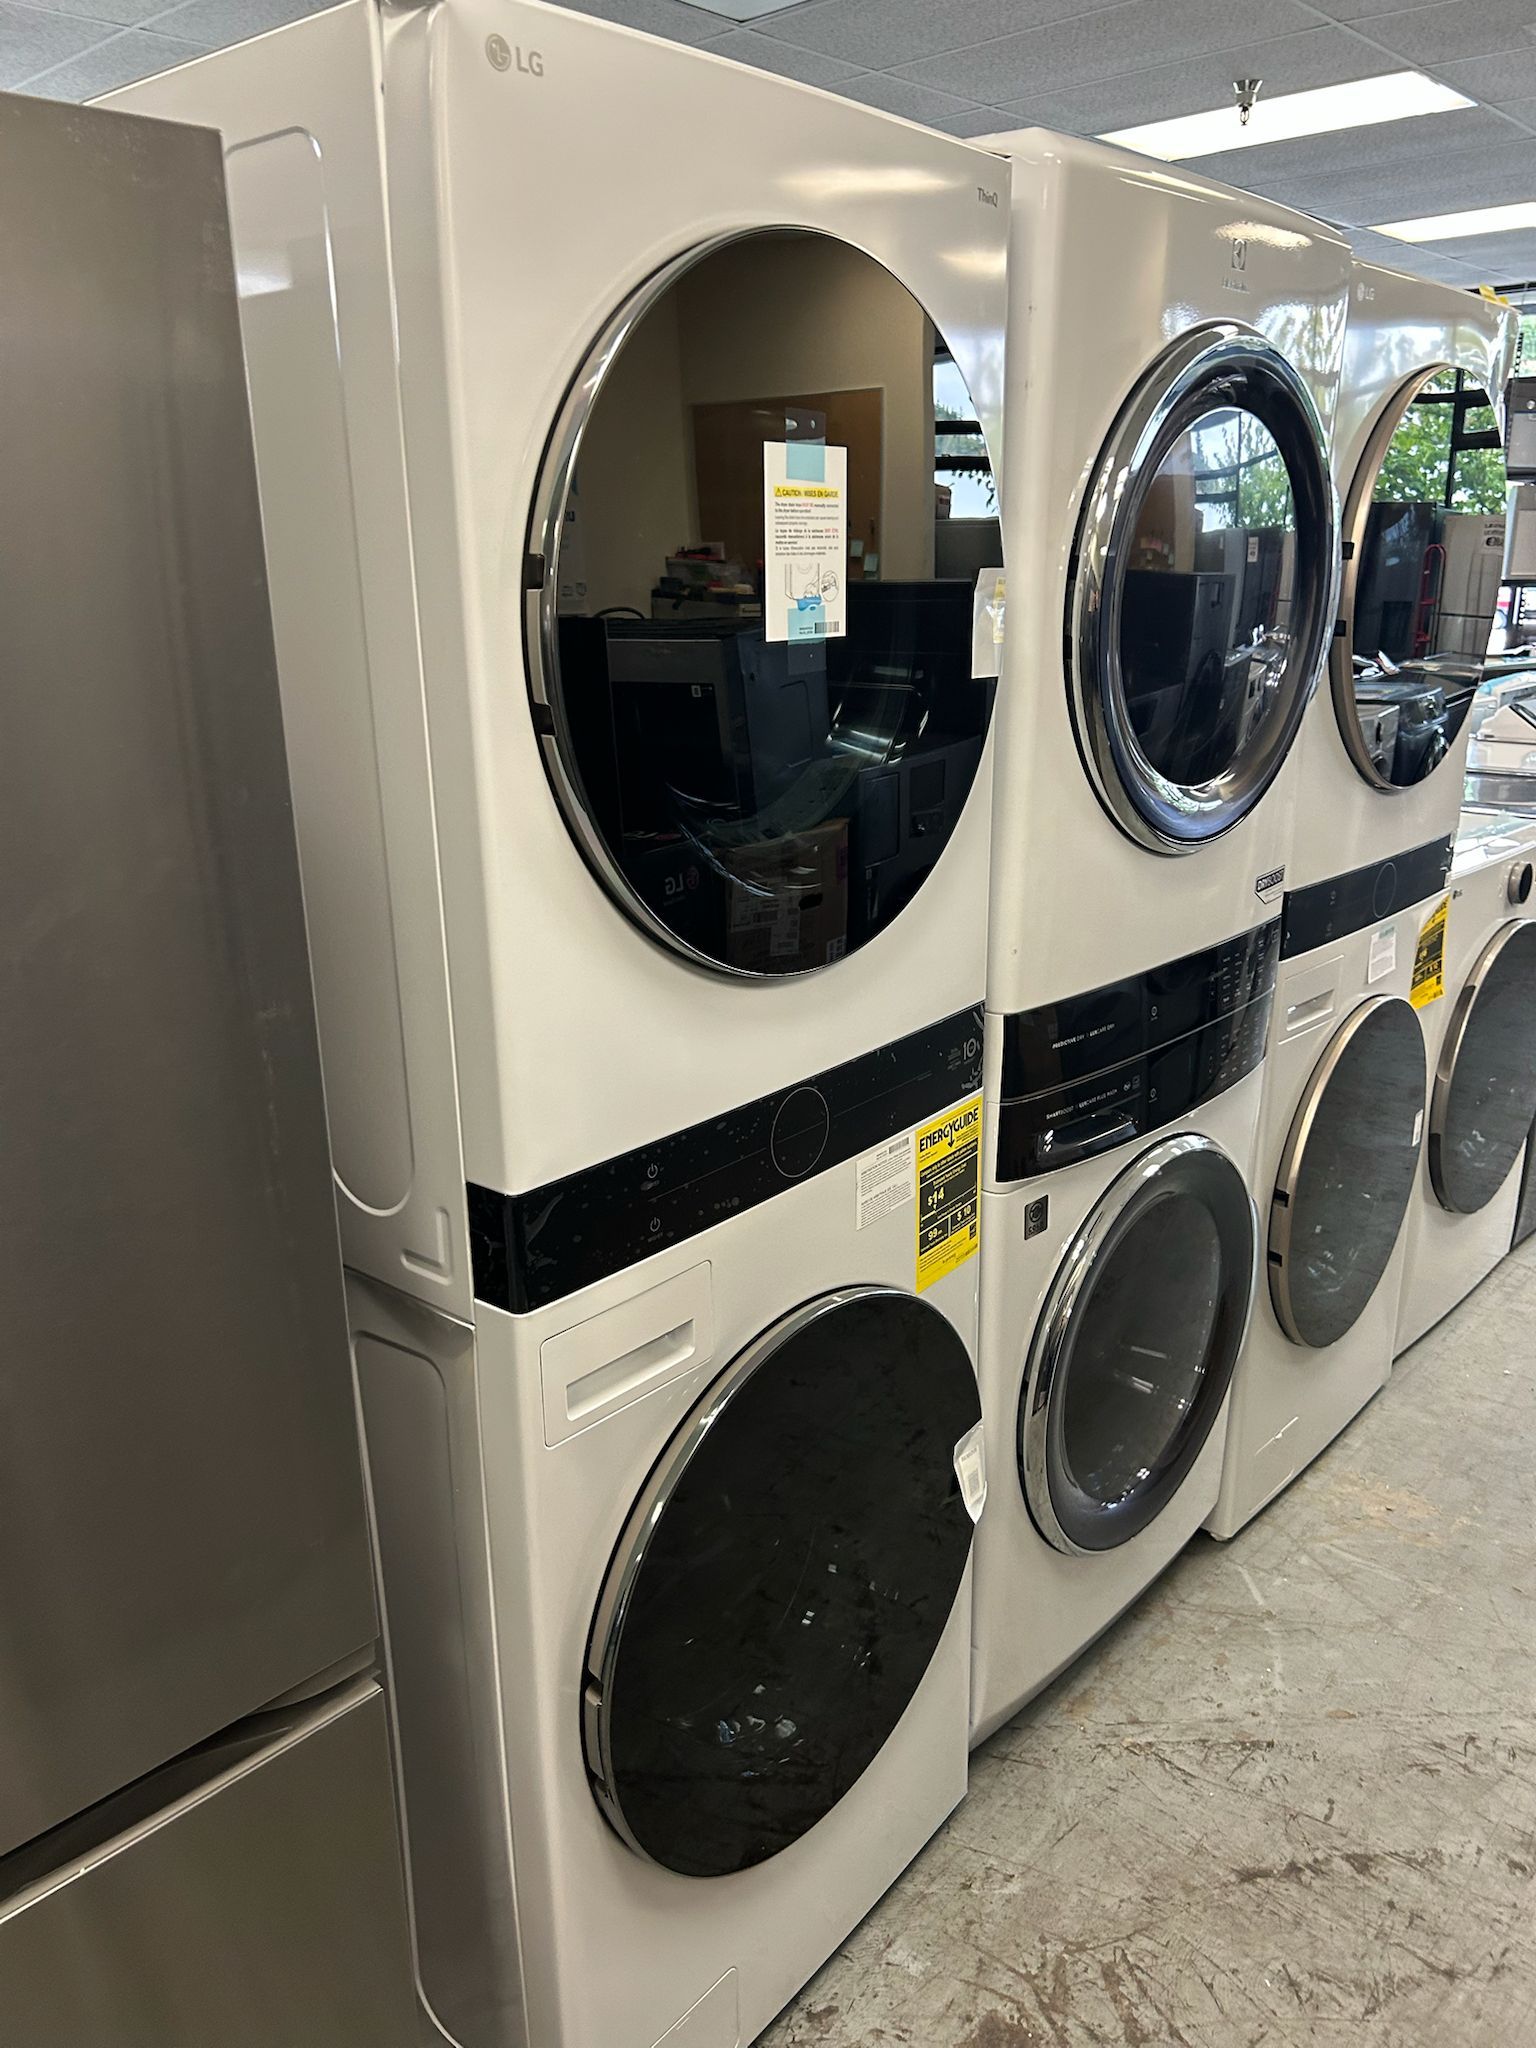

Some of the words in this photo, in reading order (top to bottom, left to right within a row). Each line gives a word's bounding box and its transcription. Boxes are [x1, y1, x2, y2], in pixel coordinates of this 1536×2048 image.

[515, 46, 544, 77] LG
[977, 187, 998, 208] ThinQ
[1365, 287, 1375, 301] LG
[920, 1107, 979, 1153] ENERGYGUIDE
